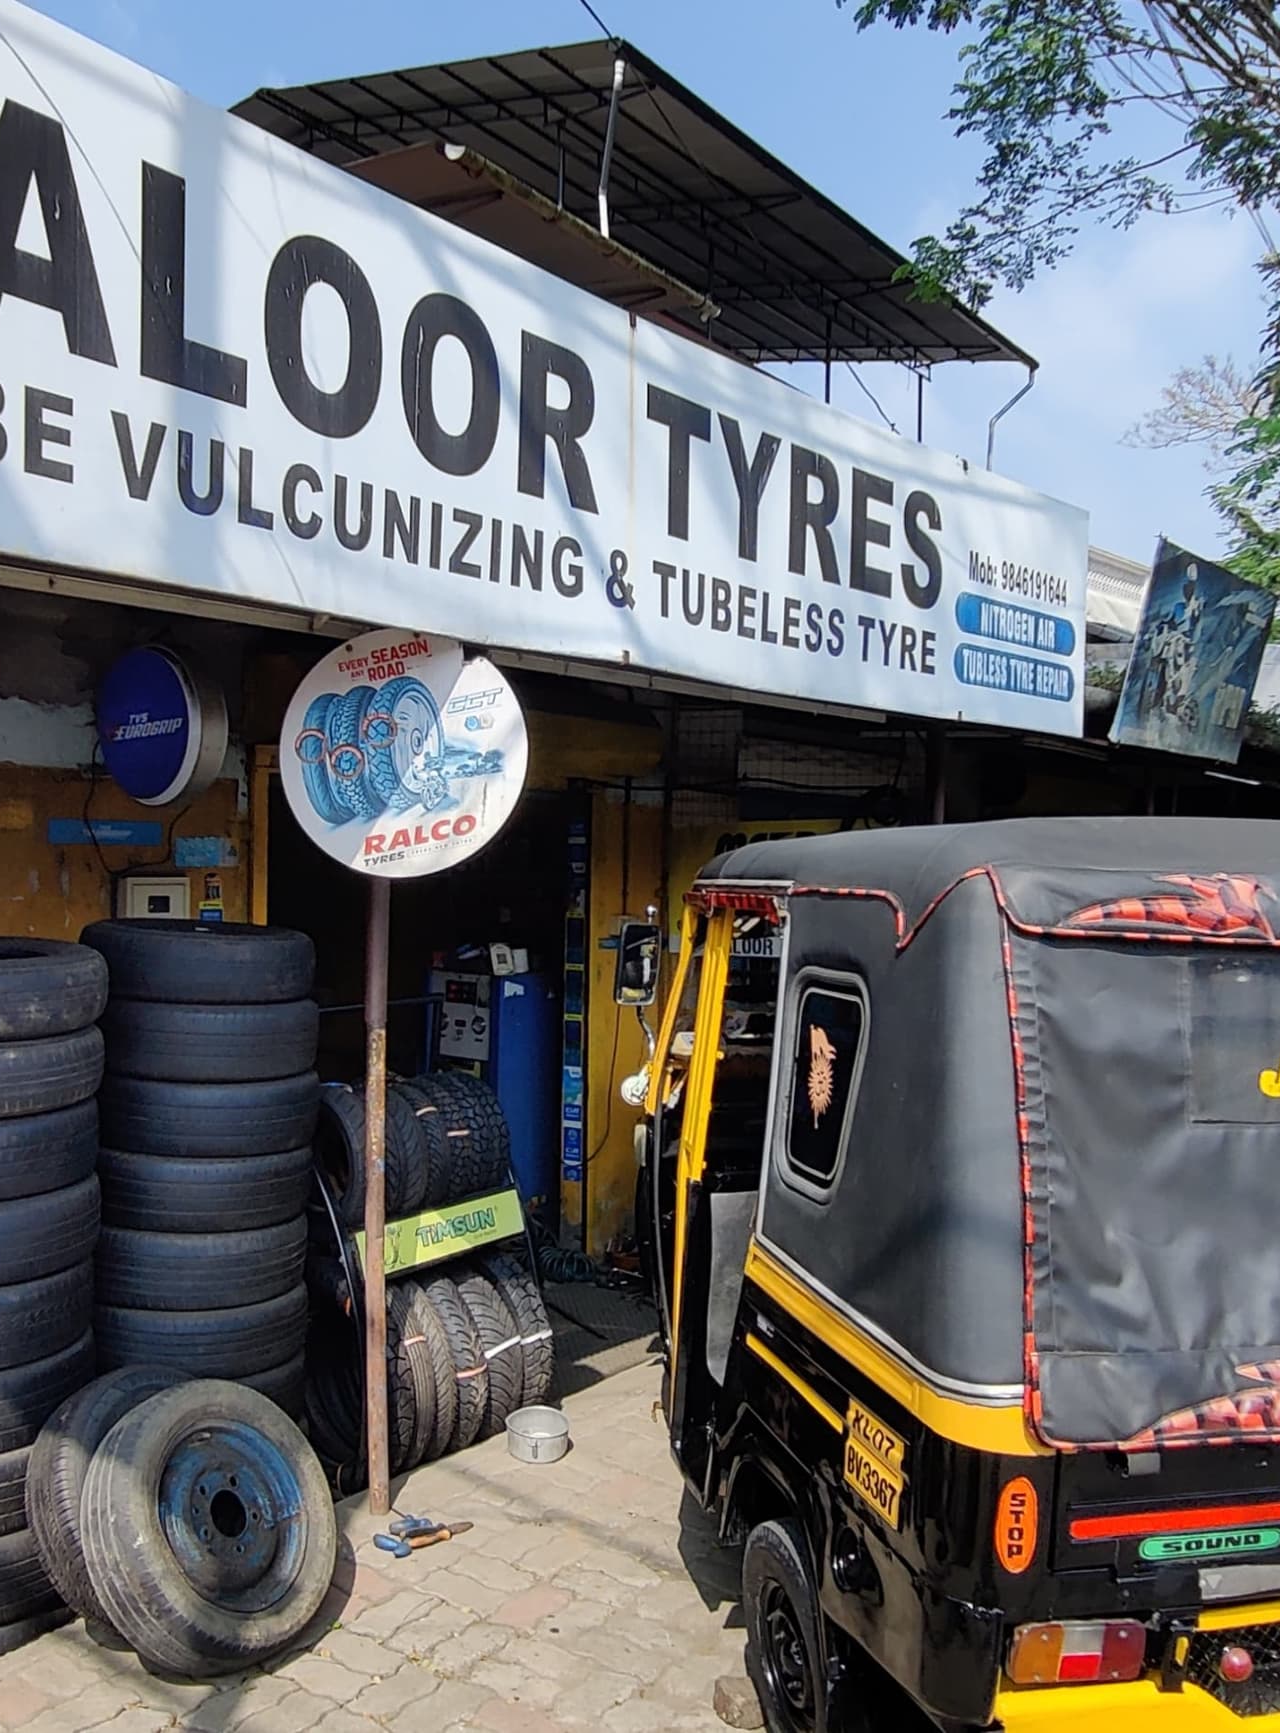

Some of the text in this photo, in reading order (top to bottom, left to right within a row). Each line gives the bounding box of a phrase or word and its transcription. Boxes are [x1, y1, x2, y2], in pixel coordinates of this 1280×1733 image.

[646, 383, 942, 610] TYRES
[111, 410, 583, 598] VULCUNIZING
[606, 550, 634, 610] &
[652, 560, 845, 657] TUBELESS
[858, 615, 936, 675] TYRE
[970, 550, 1068, 607] Mob: 9846191644
[980, 602, 1056, 649] NITROGEN AIR
[338, 639, 429, 672] EVERY SEASON
[368, 661, 405, 682] ROAD
[963, 648, 1069, 700] TUBLESS TYRE REPAIR
[114, 718, 183, 741] EUROGRIP
[128, 712, 149, 724] TVS
[364, 815, 477, 856] RALCO
[363, 851, 405, 867] TYRES
[415, 1207, 496, 1248] TIMSUN
[1007, 1493, 1026, 1559] STOP
[1162, 1534, 1261, 1553] SOUND
